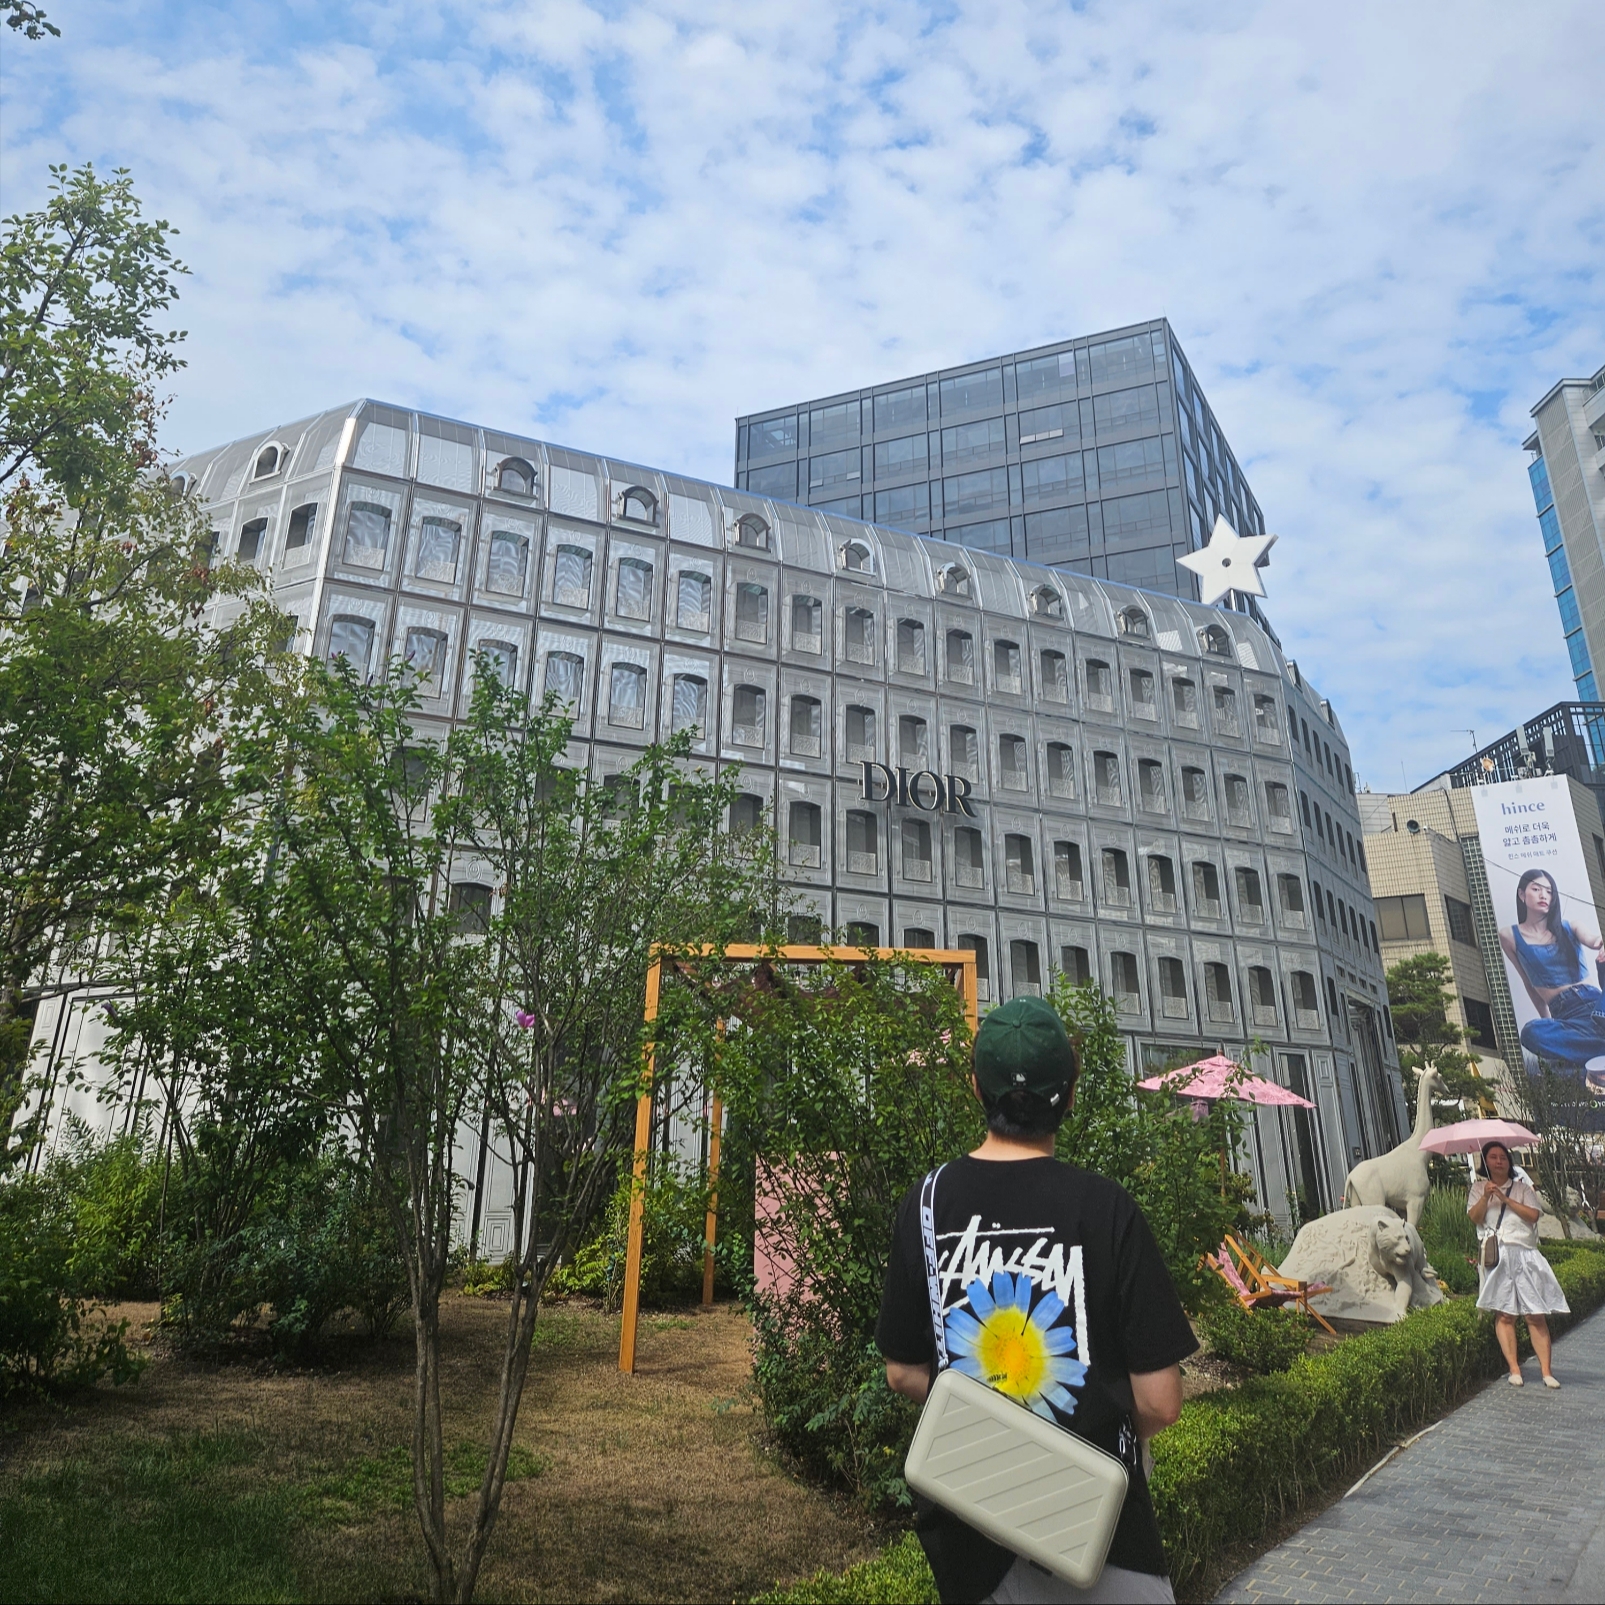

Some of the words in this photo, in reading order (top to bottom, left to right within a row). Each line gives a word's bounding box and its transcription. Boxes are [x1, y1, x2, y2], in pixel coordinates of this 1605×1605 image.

[858, 760, 977, 818] DIOR
[1501, 801, 1545, 815] hince
[1532, 821, 1549, 831] 더욱
[1503, 837, 1520, 847] 얇고
[1522, 832, 1557, 845] 촘촘하게
[922, 1204, 945, 1354] OFF-WHIT
